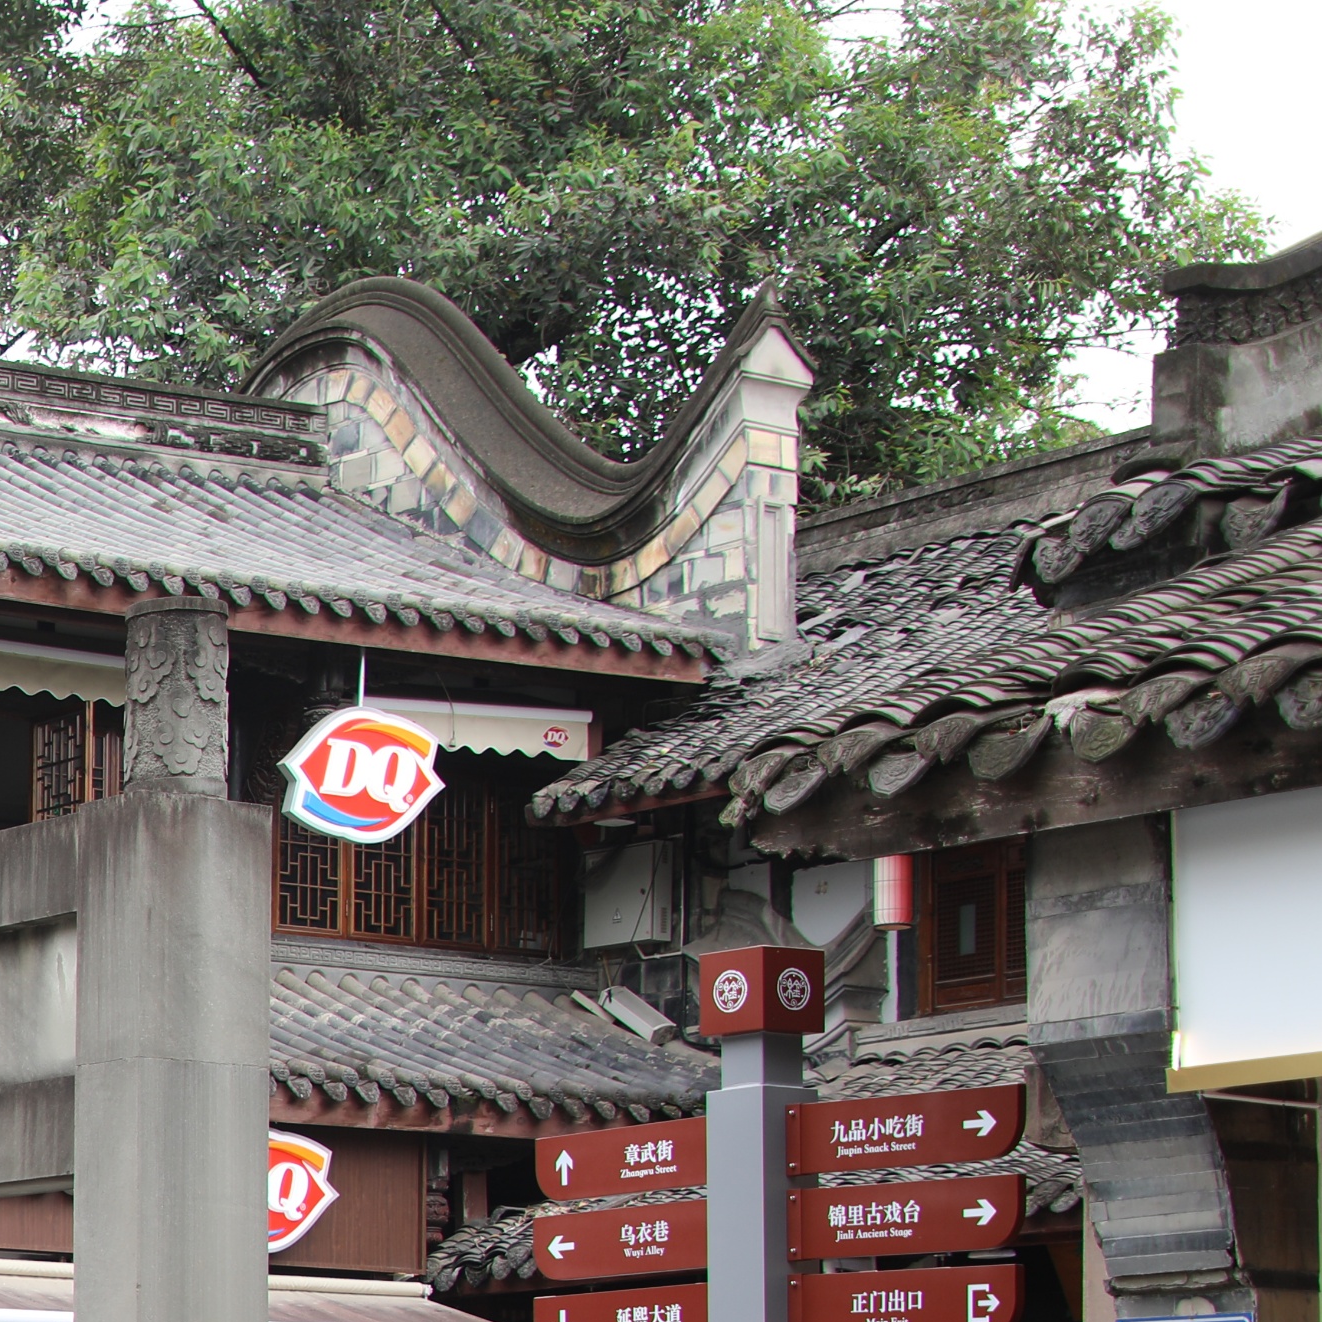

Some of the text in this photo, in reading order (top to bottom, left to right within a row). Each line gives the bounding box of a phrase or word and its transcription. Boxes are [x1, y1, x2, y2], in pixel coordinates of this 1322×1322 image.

[319, 737, 418, 814] DQ
[830, 1113, 924, 1144] 九品小吃街
[623, 1139, 673, 1166] 章武街
[836, 1141, 916, 1158] Jiupin Snack Street
[620, 1164, 677, 1179] Zhangwu Street
[268, 1161, 309, 1222] Q
[828, 1199, 921, 1229] 锦里古戏台
[619, 1220, 669, 1246] 乌衣巷
[835, 1227, 913, 1242] Jinli Ancient Stage
[623, 1245, 665, 1259] Wuyi Alley
[850, 1289, 923, 1314] 正门出口
